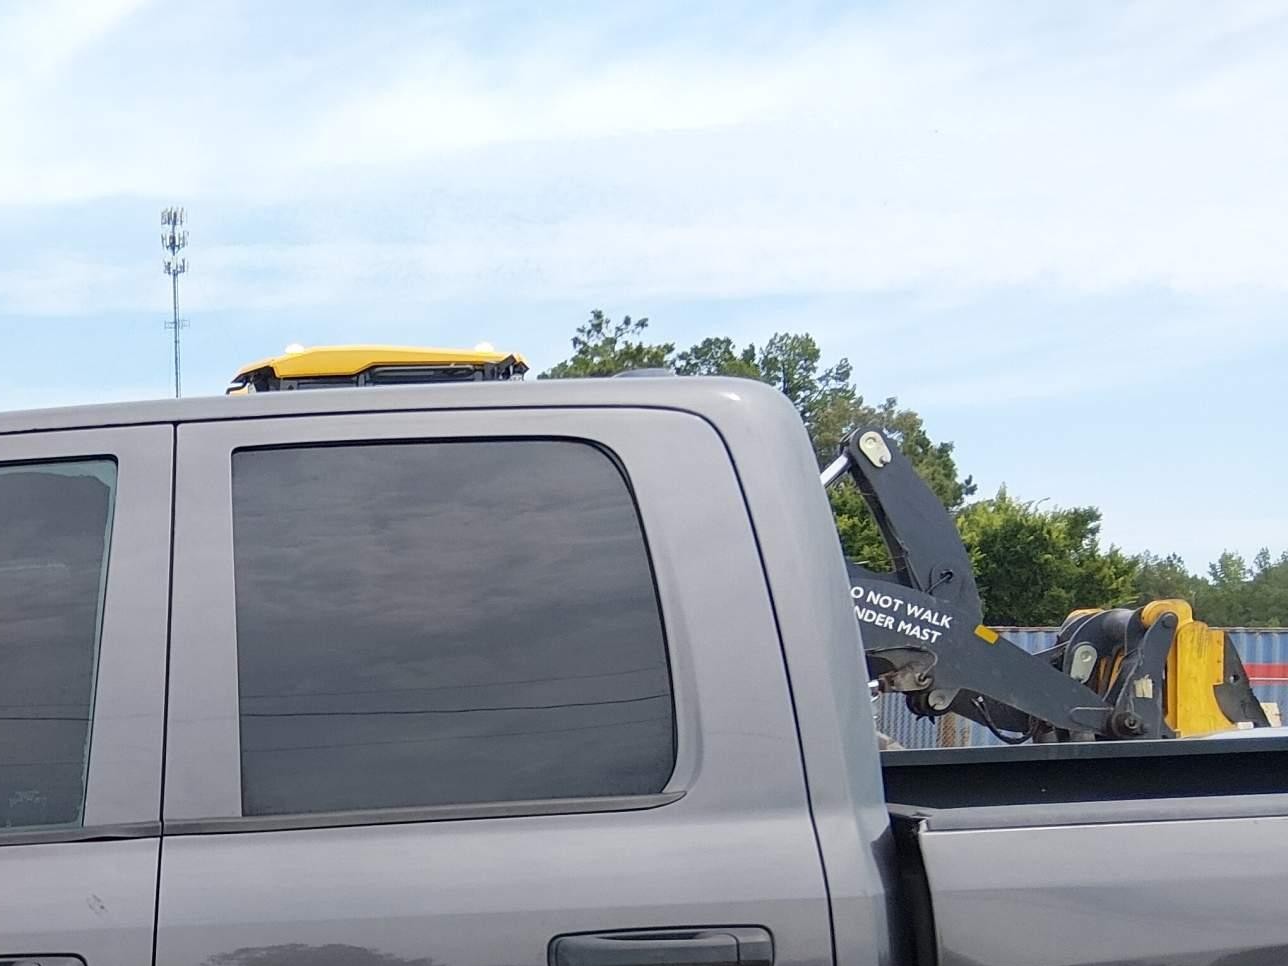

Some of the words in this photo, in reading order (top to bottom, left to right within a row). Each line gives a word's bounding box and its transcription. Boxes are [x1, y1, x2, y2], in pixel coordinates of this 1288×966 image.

[850, 586, 864, 599] O
[866, 590, 904, 612] NOT
[907, 603, 953, 629] WALK
[854, 605, 895, 630] NDER
[896, 620, 942, 643] MAST
